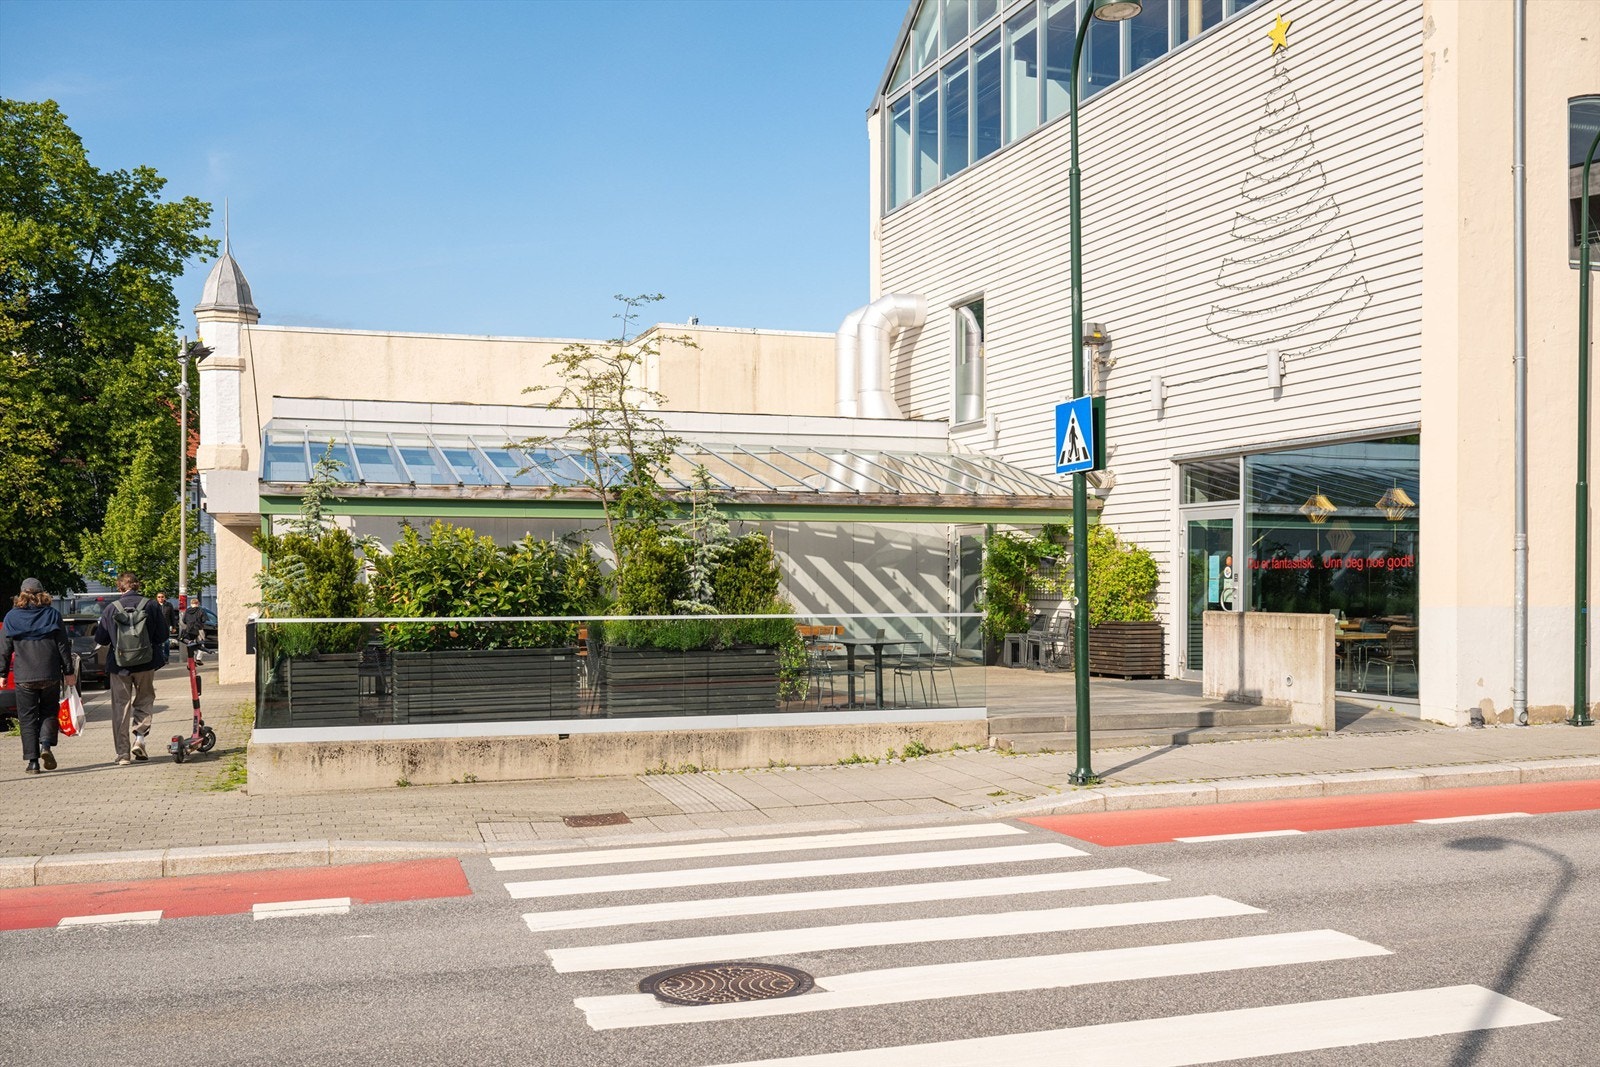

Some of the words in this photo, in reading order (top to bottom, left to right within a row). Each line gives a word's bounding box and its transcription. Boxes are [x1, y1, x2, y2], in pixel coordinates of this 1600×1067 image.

[1247, 557, 1260, 569] Du
[1261, 559, 1270, 569] er
[1271, 556, 1315, 569] fantastisk.
[1323, 555, 1343, 569] Unn
[1345, 556, 1364, 571] deg
[1366, 558, 1385, 568] noe
[1387, 554, 1414, 571] godt!
